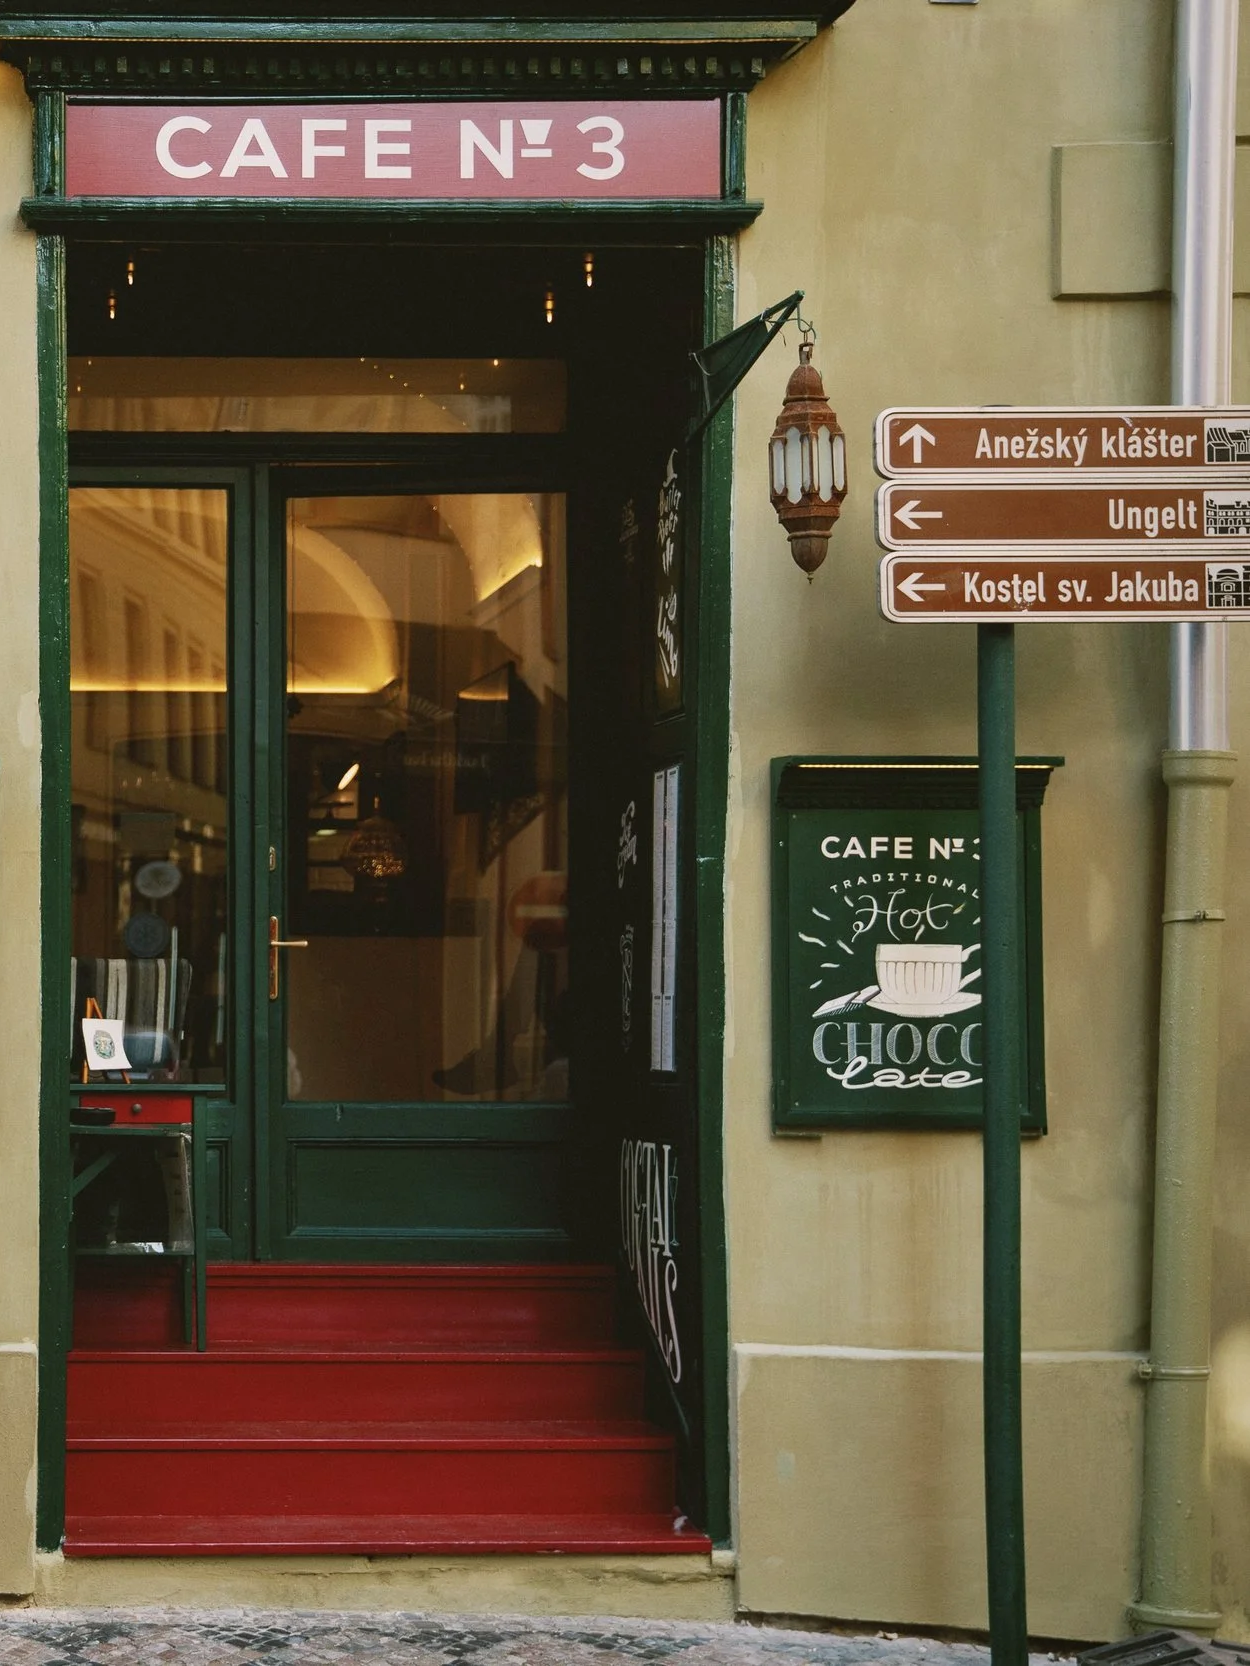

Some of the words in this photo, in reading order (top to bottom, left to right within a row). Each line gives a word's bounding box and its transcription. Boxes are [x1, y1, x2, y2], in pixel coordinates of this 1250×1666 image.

[155, 115, 412, 180] CAFE
[576, 115, 626, 180] 3
[975, 427, 1088, 466] Anežský
[1101, 427, 1198, 458] klášter
[1108, 498, 1198, 538] Ungelt
[964, 571, 1046, 603] Kostel
[1058, 579, 1092, 603] sv.
[1104, 570, 1199, 603] Jakuba
[820, 836, 913, 860] CAFE
[830, 872, 980, 899] TRADITIONAL
[852, 888, 955, 944] Hot
